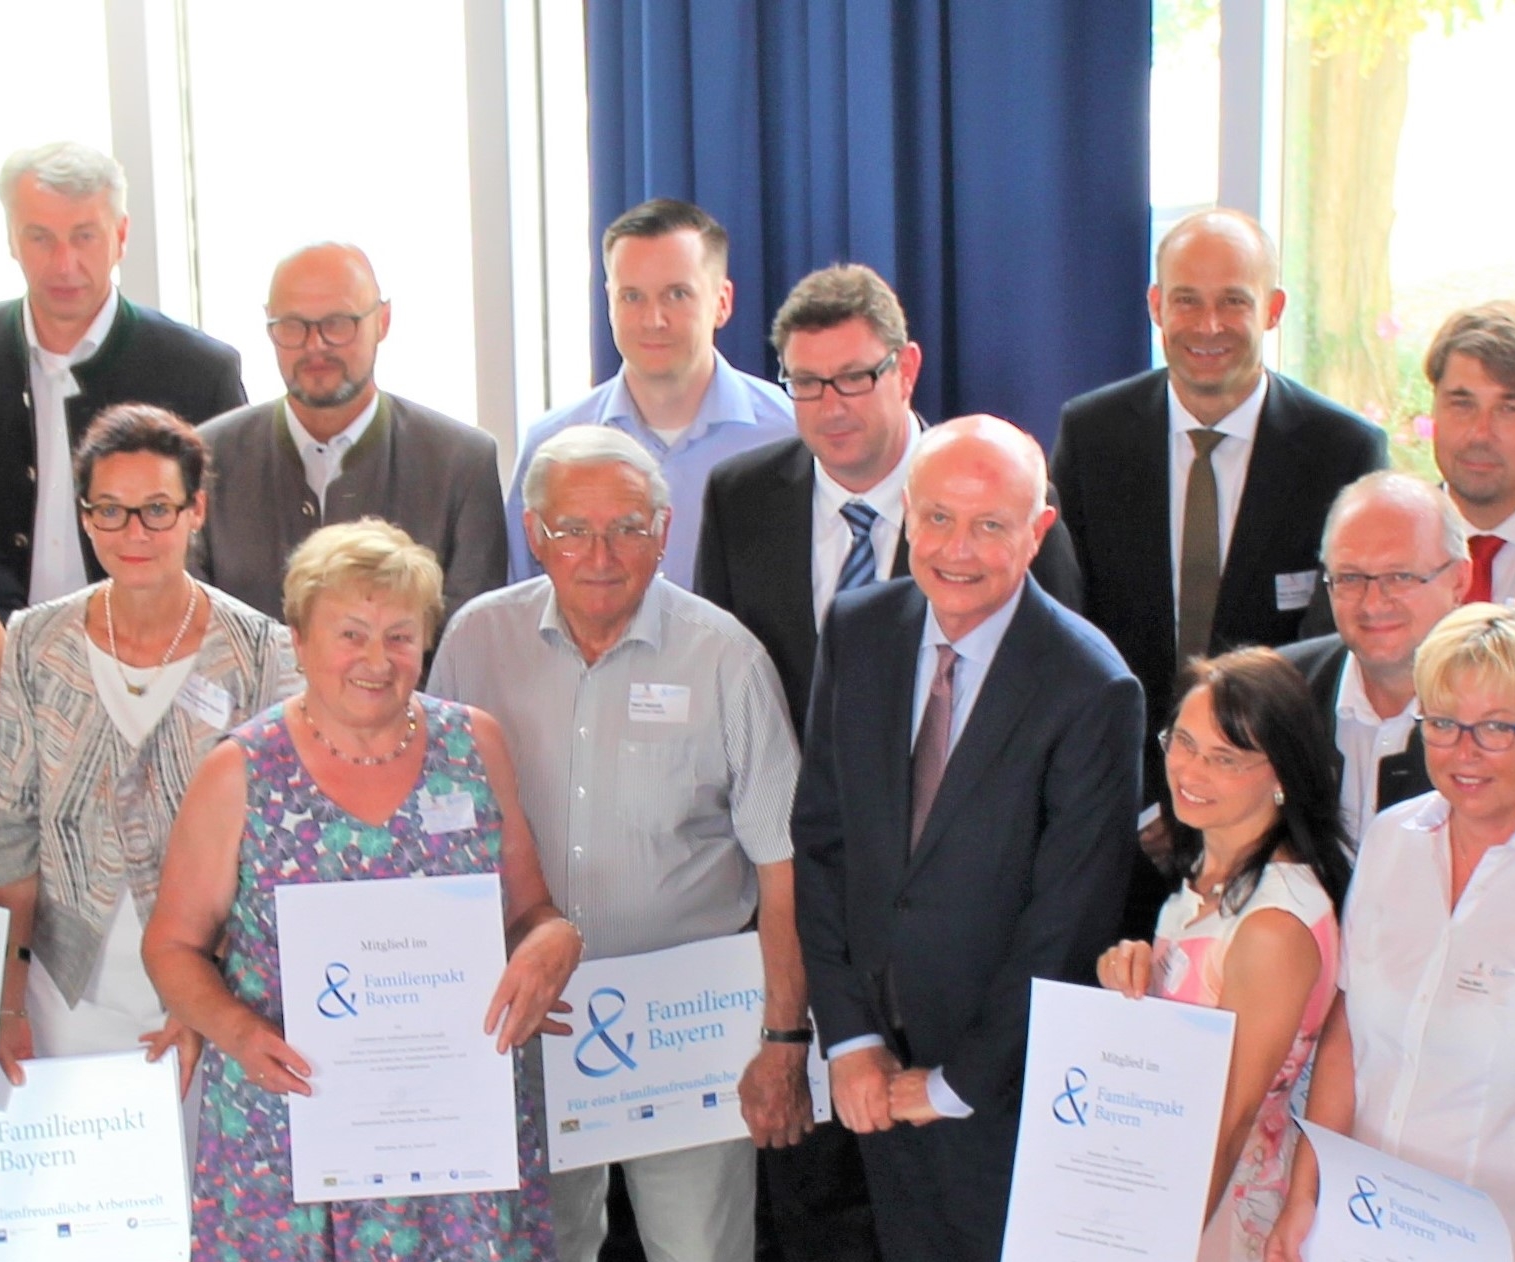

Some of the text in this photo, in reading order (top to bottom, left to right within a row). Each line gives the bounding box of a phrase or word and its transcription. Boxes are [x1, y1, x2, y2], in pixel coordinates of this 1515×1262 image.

[361, 936, 428, 953] Mitglied im
[364, 968, 466, 990] Familienpakt
[365, 989, 420, 1008] Bayern
[646, 986, 765, 1023] Familienp
[648, 1021, 725, 1052] Bayern
[1101, 1051, 1160, 1072] Mitglied im
[567, 1071, 737, 1112] Für eine familienfreundliche
[1096, 1086, 1185, 1118] Familienpakt
[1094, 1105, 1141, 1129] Bayern
[96, 1194, 164, 1212] Arbeitswelt
[1388, 1197, 1477, 1243] Familienpakt
[1389, 1212, 1436, 1242] Bayern
